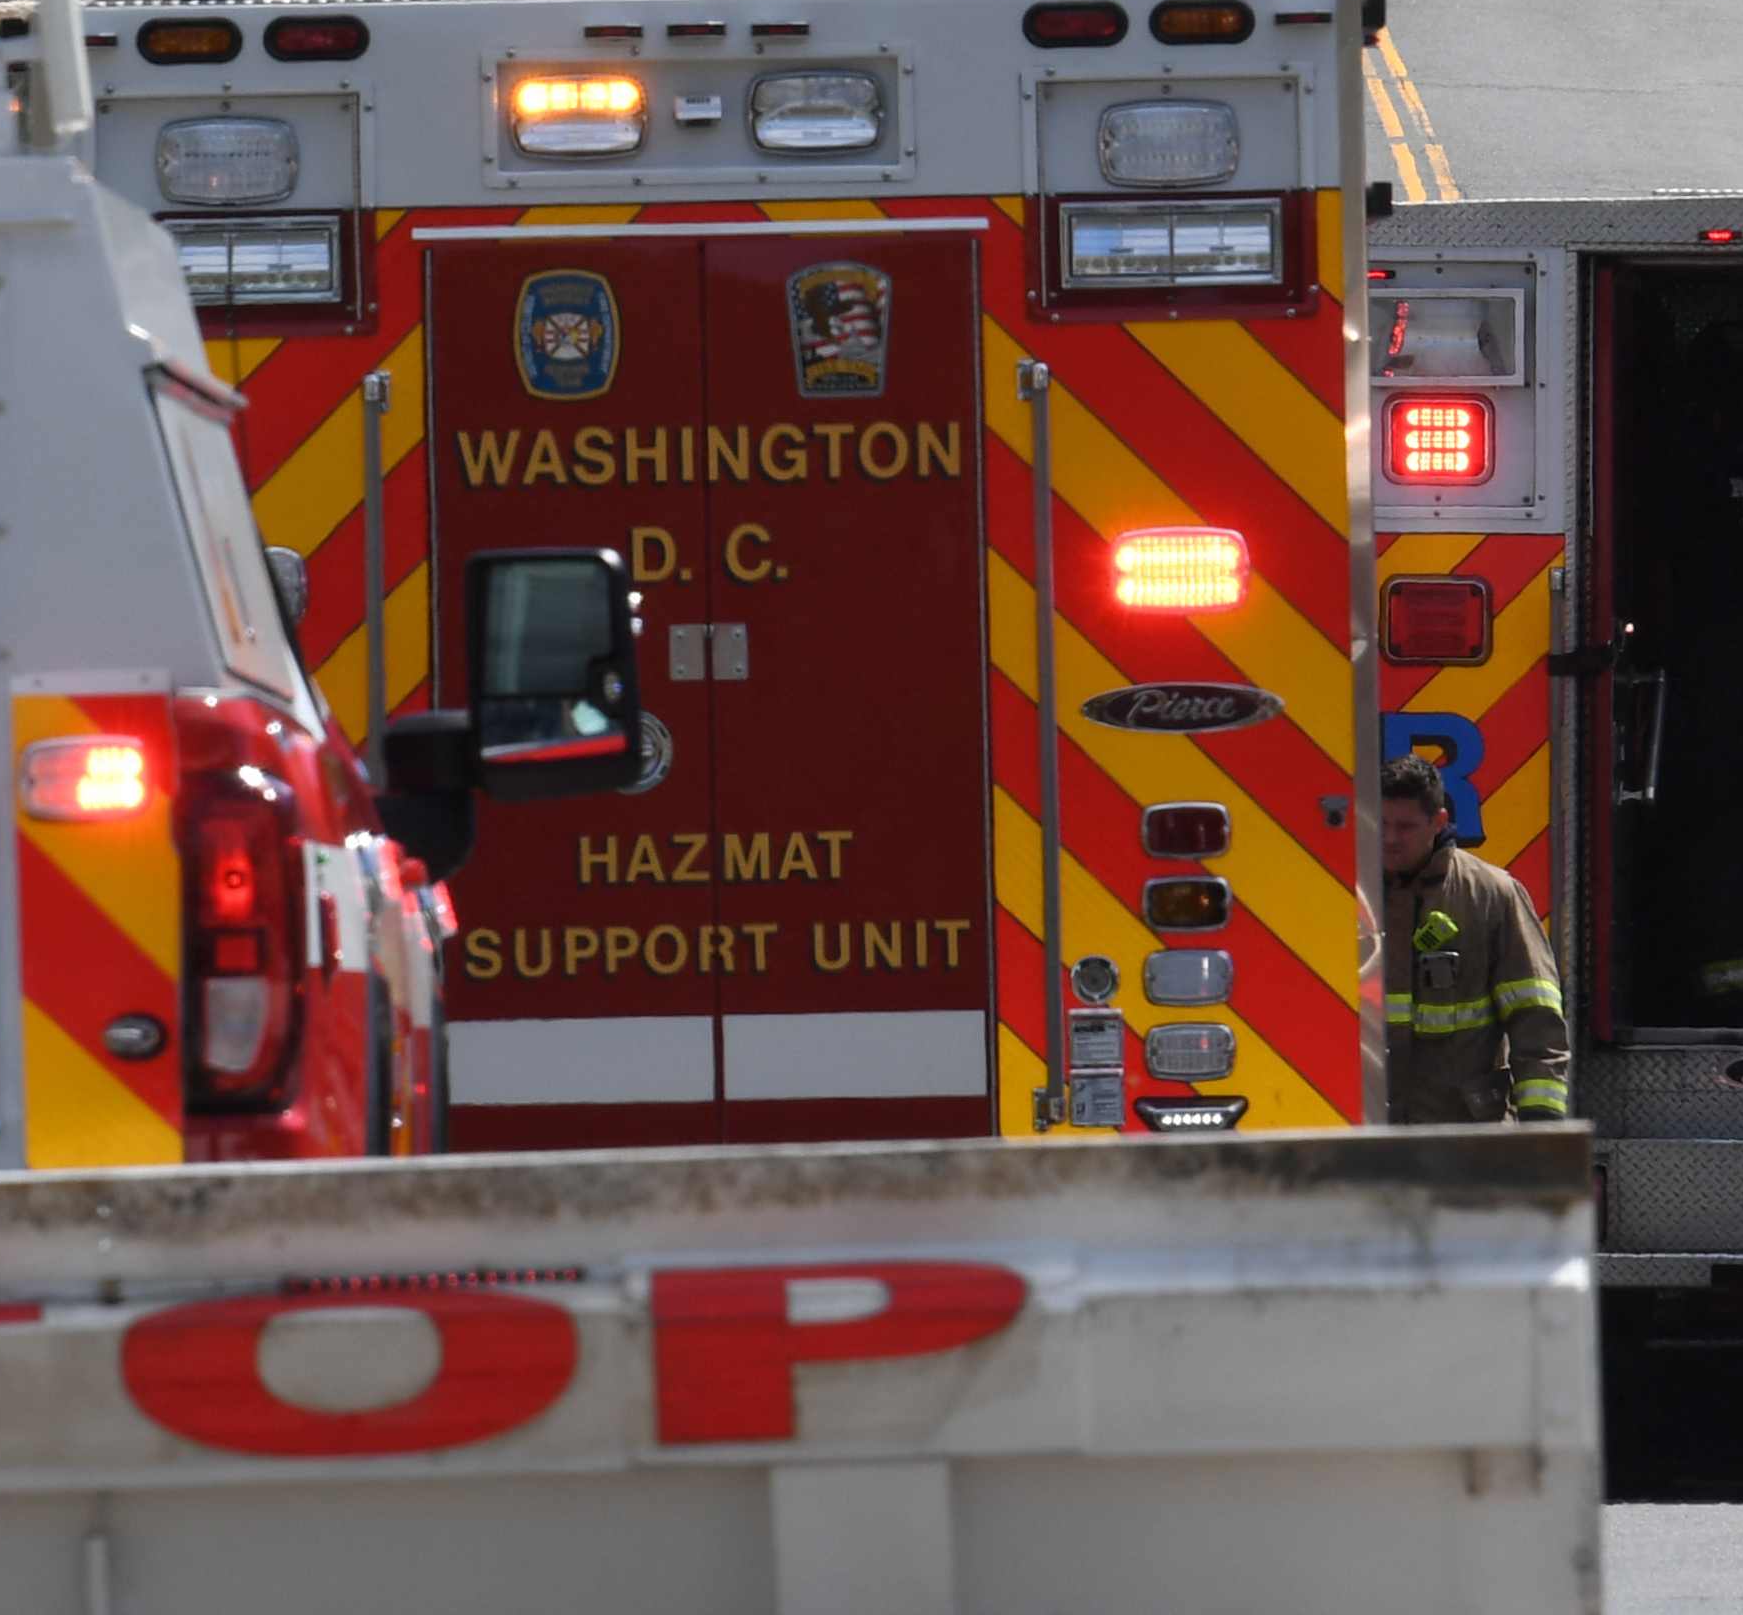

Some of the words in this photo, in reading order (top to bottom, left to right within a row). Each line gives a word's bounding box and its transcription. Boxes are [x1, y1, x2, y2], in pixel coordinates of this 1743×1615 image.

[457, 421, 965, 488] WASHINGTON
[631, 525, 693, 583] D.
[724, 523, 789, 583] C.
[1126, 689, 1237, 726] Pierce
[579, 830, 853, 884] HAZMAT
[464, 922, 779, 978] SUPPORT
[813, 920, 970, 971] UNIT
